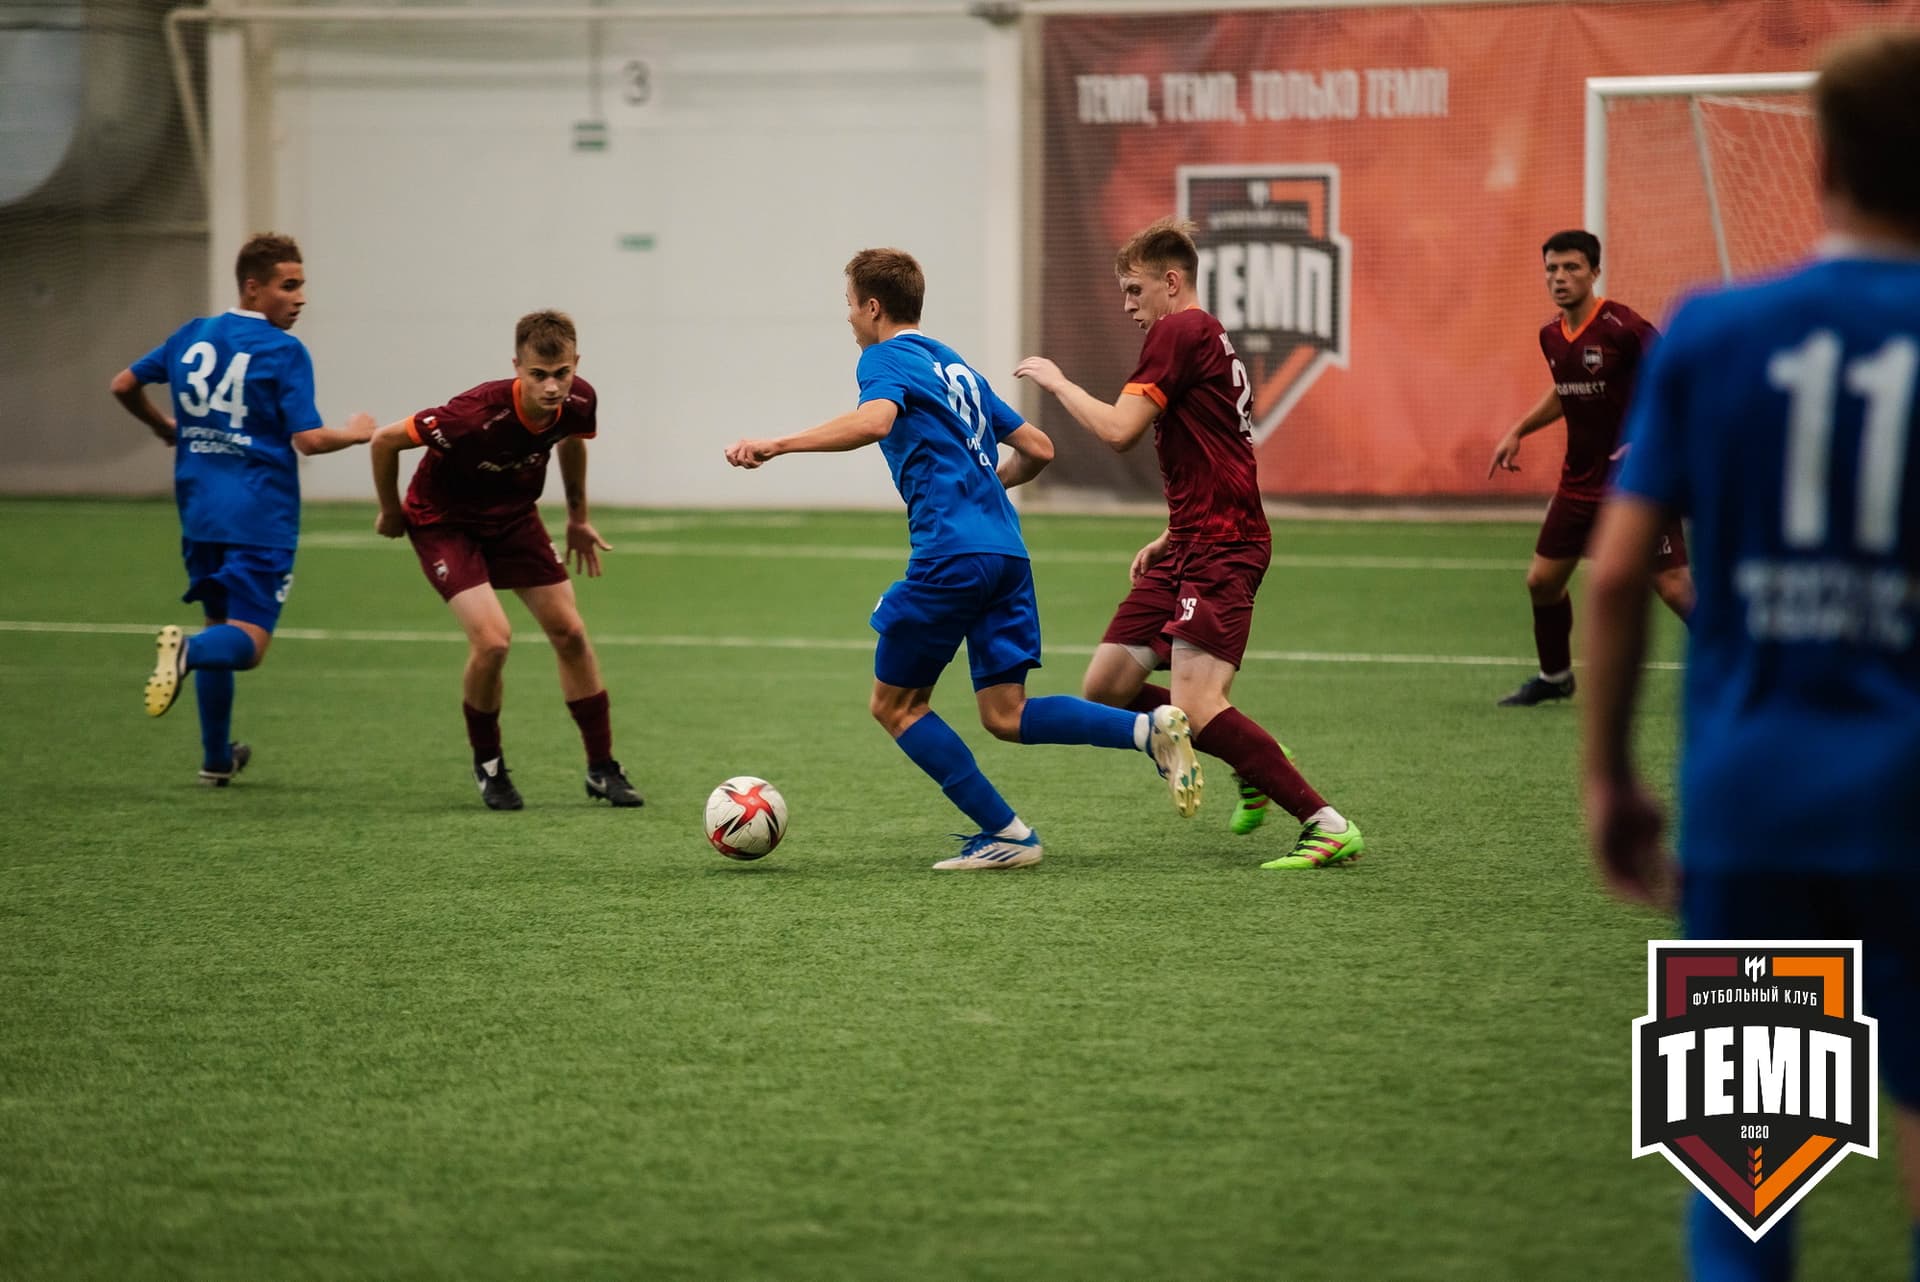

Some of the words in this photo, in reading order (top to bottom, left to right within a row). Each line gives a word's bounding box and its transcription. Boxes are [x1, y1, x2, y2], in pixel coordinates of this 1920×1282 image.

[621, 59, 652, 108] 3
[179, 341, 252, 429] 34
[1767, 329, 1920, 552] 11
